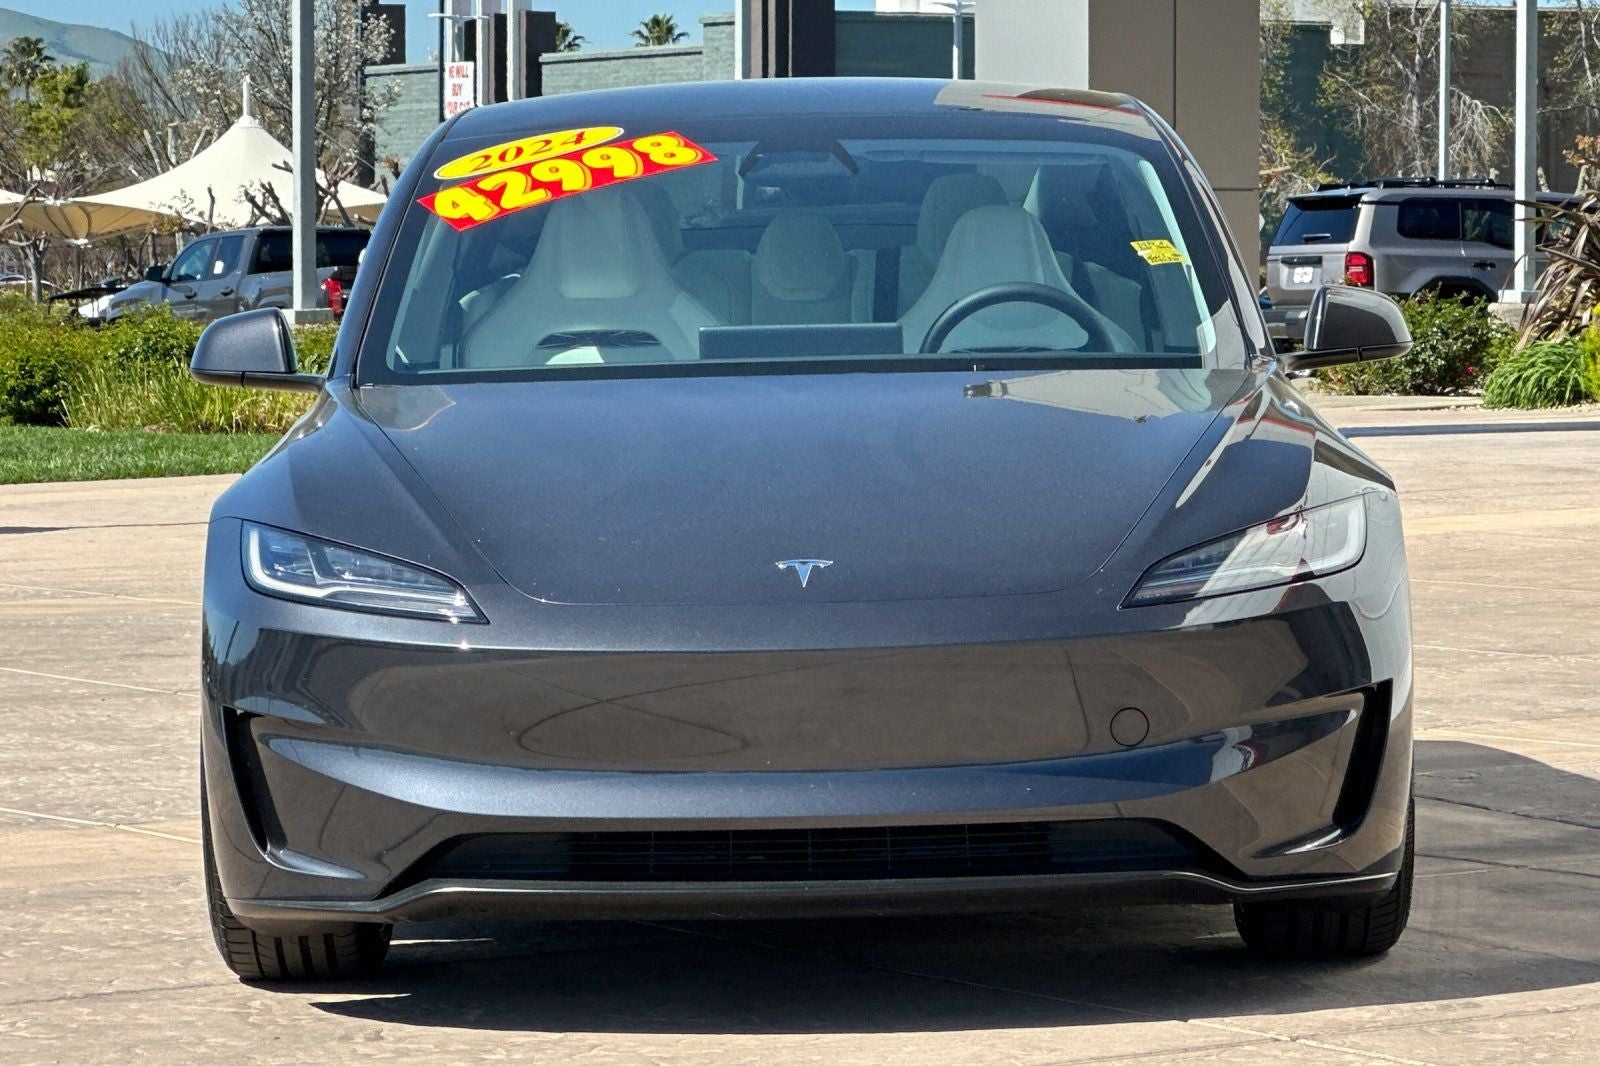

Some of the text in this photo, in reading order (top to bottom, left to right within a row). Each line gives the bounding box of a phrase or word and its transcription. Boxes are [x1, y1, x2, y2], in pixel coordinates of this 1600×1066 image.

[455, 65, 469, 78] WILL
[452, 83, 463, 96] BUY
[470, 131, 589, 171] 2024
[434, 134, 702, 221] 42998
